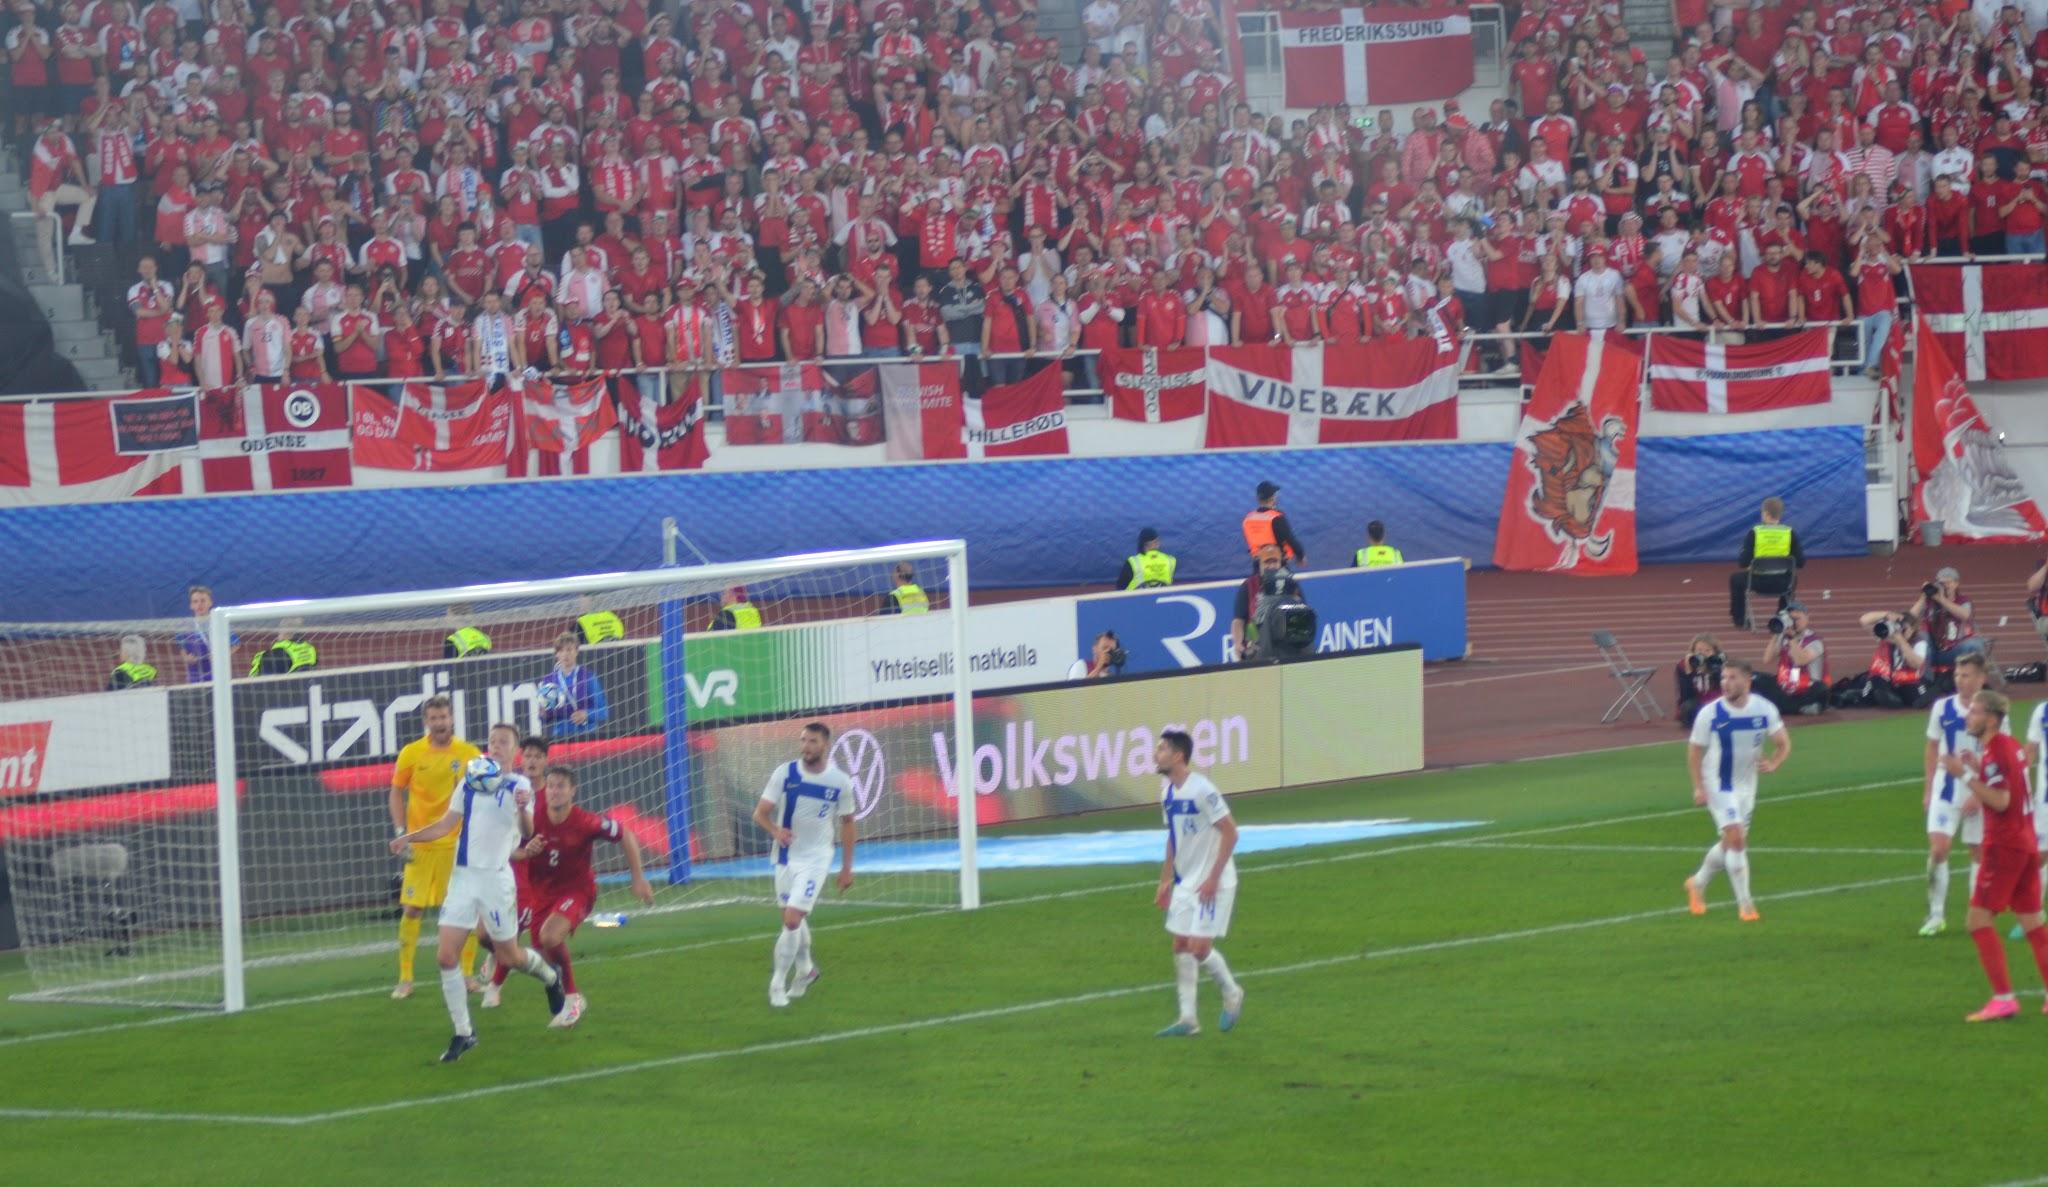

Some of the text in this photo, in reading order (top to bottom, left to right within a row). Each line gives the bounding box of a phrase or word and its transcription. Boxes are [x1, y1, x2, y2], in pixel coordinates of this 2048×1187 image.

[1299, 20, 1444, 43] FREDERIKSSUND
[1238, 372, 1399, 416] VIDEBÆK
[968, 411, 1065, 442] HILLERØD
[240, 434, 307, 453] ODENSE
[1222, 615, 1393, 665] RAINEN
[684, 669, 739, 708] VR
[932, 714, 1249, 798] Volkswaen
[818, 803, 829, 818] 2
[549, 849, 560, 867] 2
[804, 879, 816, 898] 2
[489, 909, 501, 928] 4
